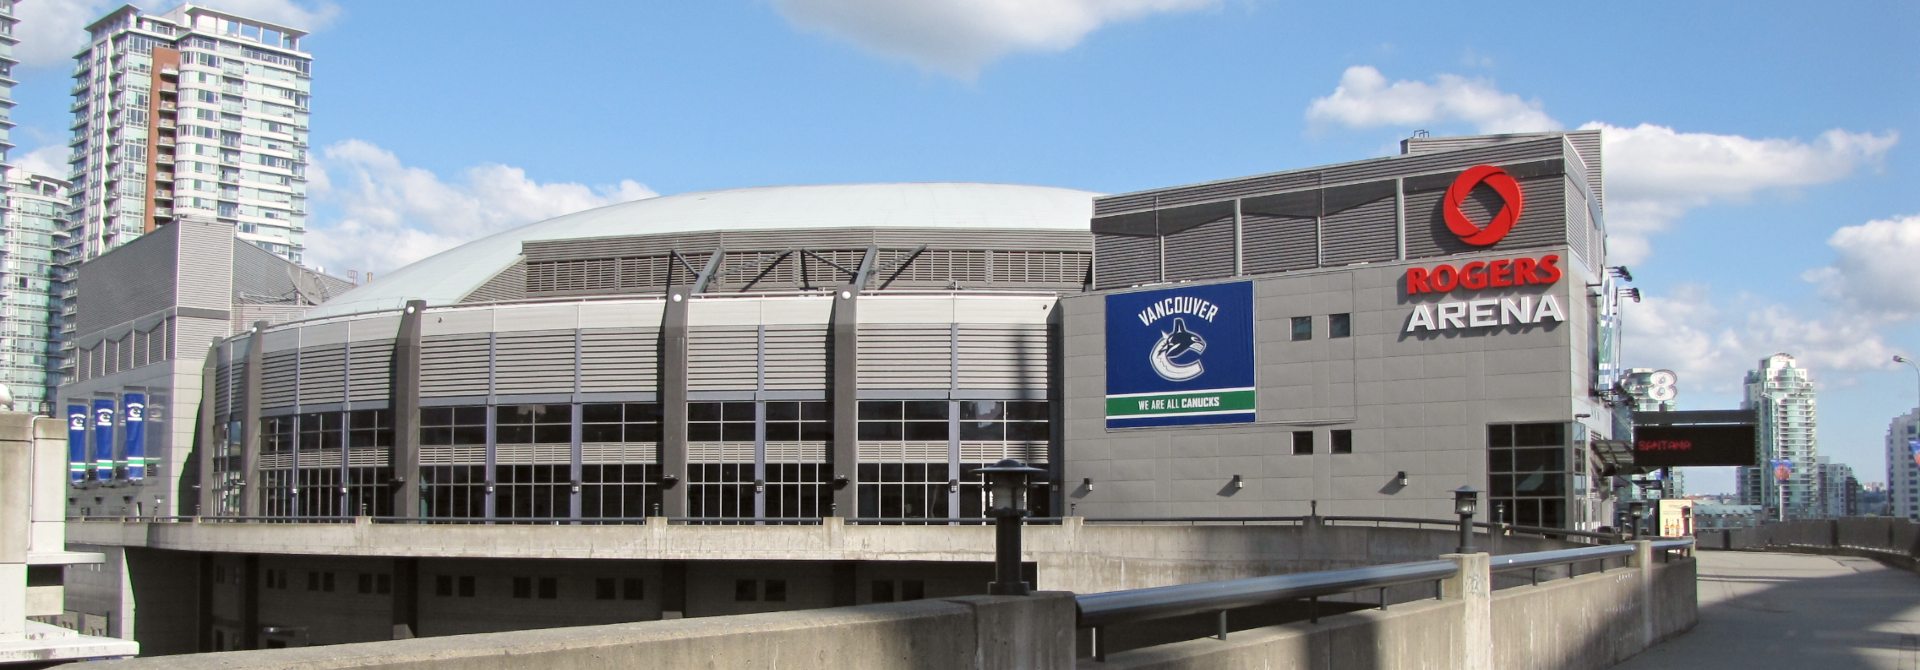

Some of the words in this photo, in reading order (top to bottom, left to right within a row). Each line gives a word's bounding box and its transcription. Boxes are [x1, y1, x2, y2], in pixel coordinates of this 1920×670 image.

[1406, 254, 1563, 294] ROGERS
[1138, 296, 1219, 327] VANCOUVER
[1406, 295, 1565, 332] ARENA
[1648, 369, 1677, 401] 8
[1138, 400, 1149, 411] WE
[1151, 399, 1165, 410] ARE
[1167, 398, 1180, 409] ALL
[1181, 397, 1220, 408] CANUCKS
